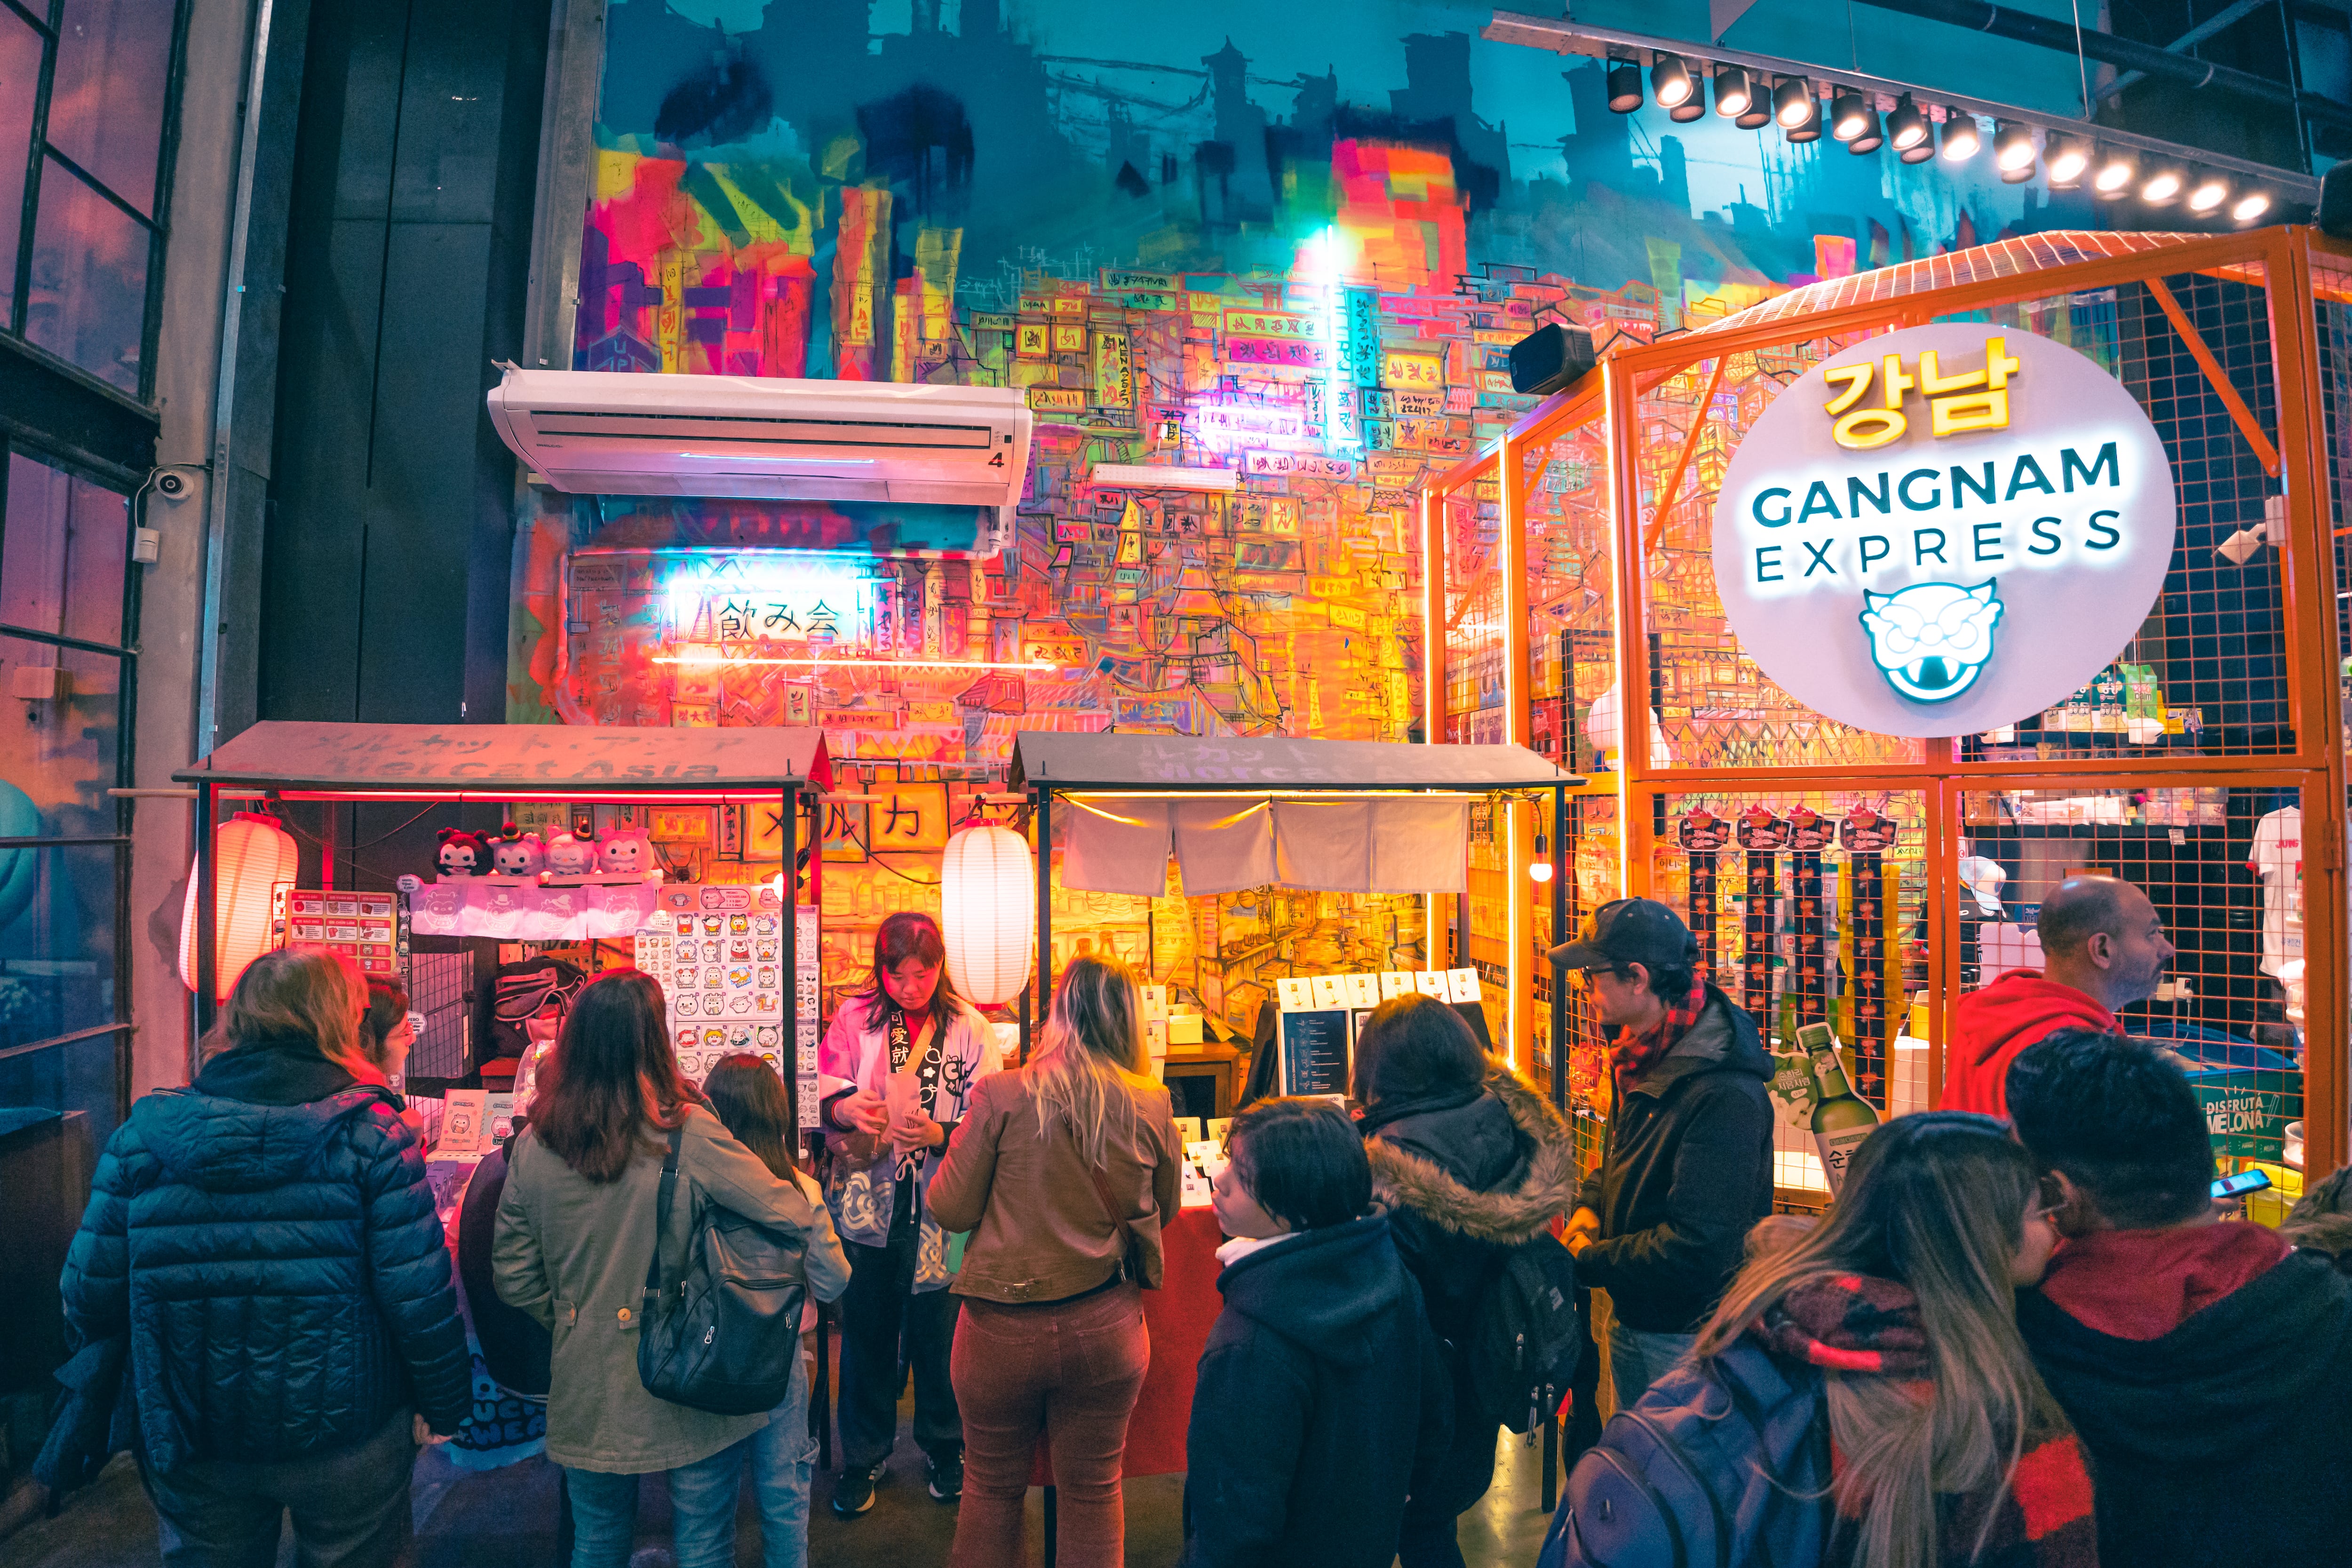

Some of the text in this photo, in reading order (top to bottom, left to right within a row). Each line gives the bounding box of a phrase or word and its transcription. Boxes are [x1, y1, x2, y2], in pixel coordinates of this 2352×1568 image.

[1824, 336, 2020, 450] 강남
[988, 452, 1004, 467] 4
[1752, 442, 2120, 527] GANGNAM
[1756, 509, 2120, 582] EXPRESS
[719, 597, 842, 640] 飲み会
[573, 759, 719, 778] Asia
[2207, 1109, 2264, 1135] MELONA
